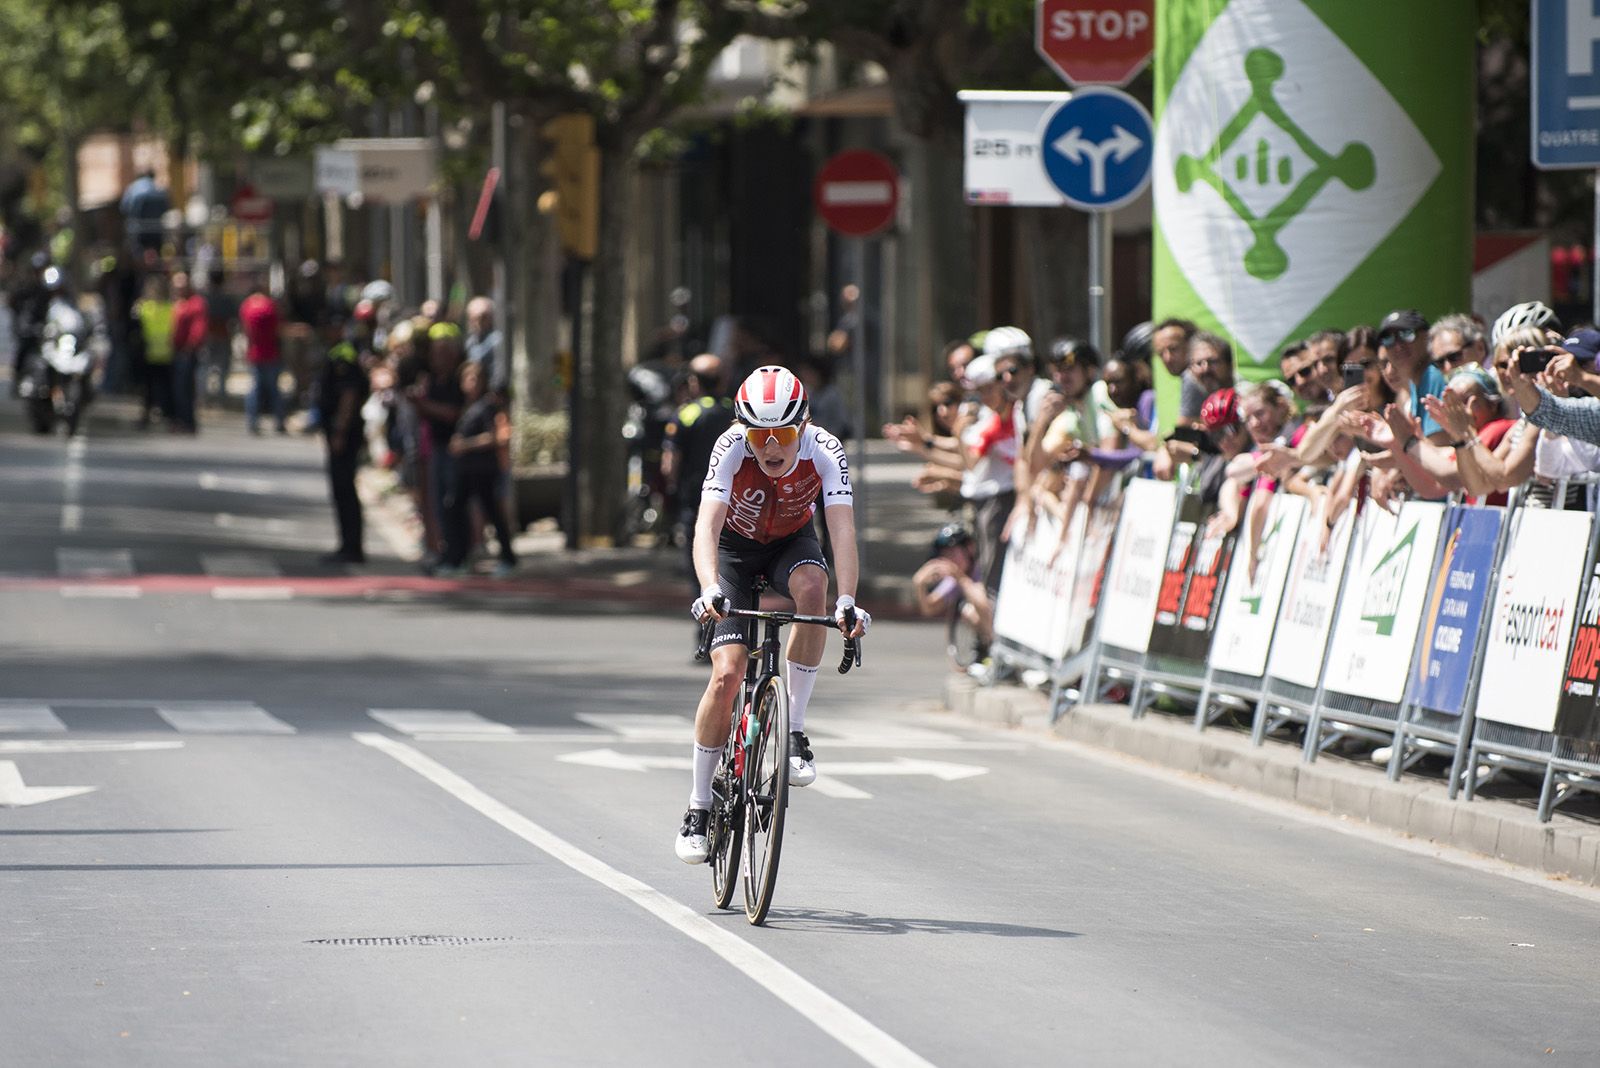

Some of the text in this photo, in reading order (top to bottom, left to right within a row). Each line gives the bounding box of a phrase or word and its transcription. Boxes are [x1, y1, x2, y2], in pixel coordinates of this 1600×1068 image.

[1051, 9, 1149, 40] STOP
[975, 139, 1010, 156] 25
[1540, 129, 1599, 147] QUATRE
[815, 431, 849, 486] Cofidis
[726, 488, 766, 539] Cofidis
[1505, 596, 1566, 661] esportcat
